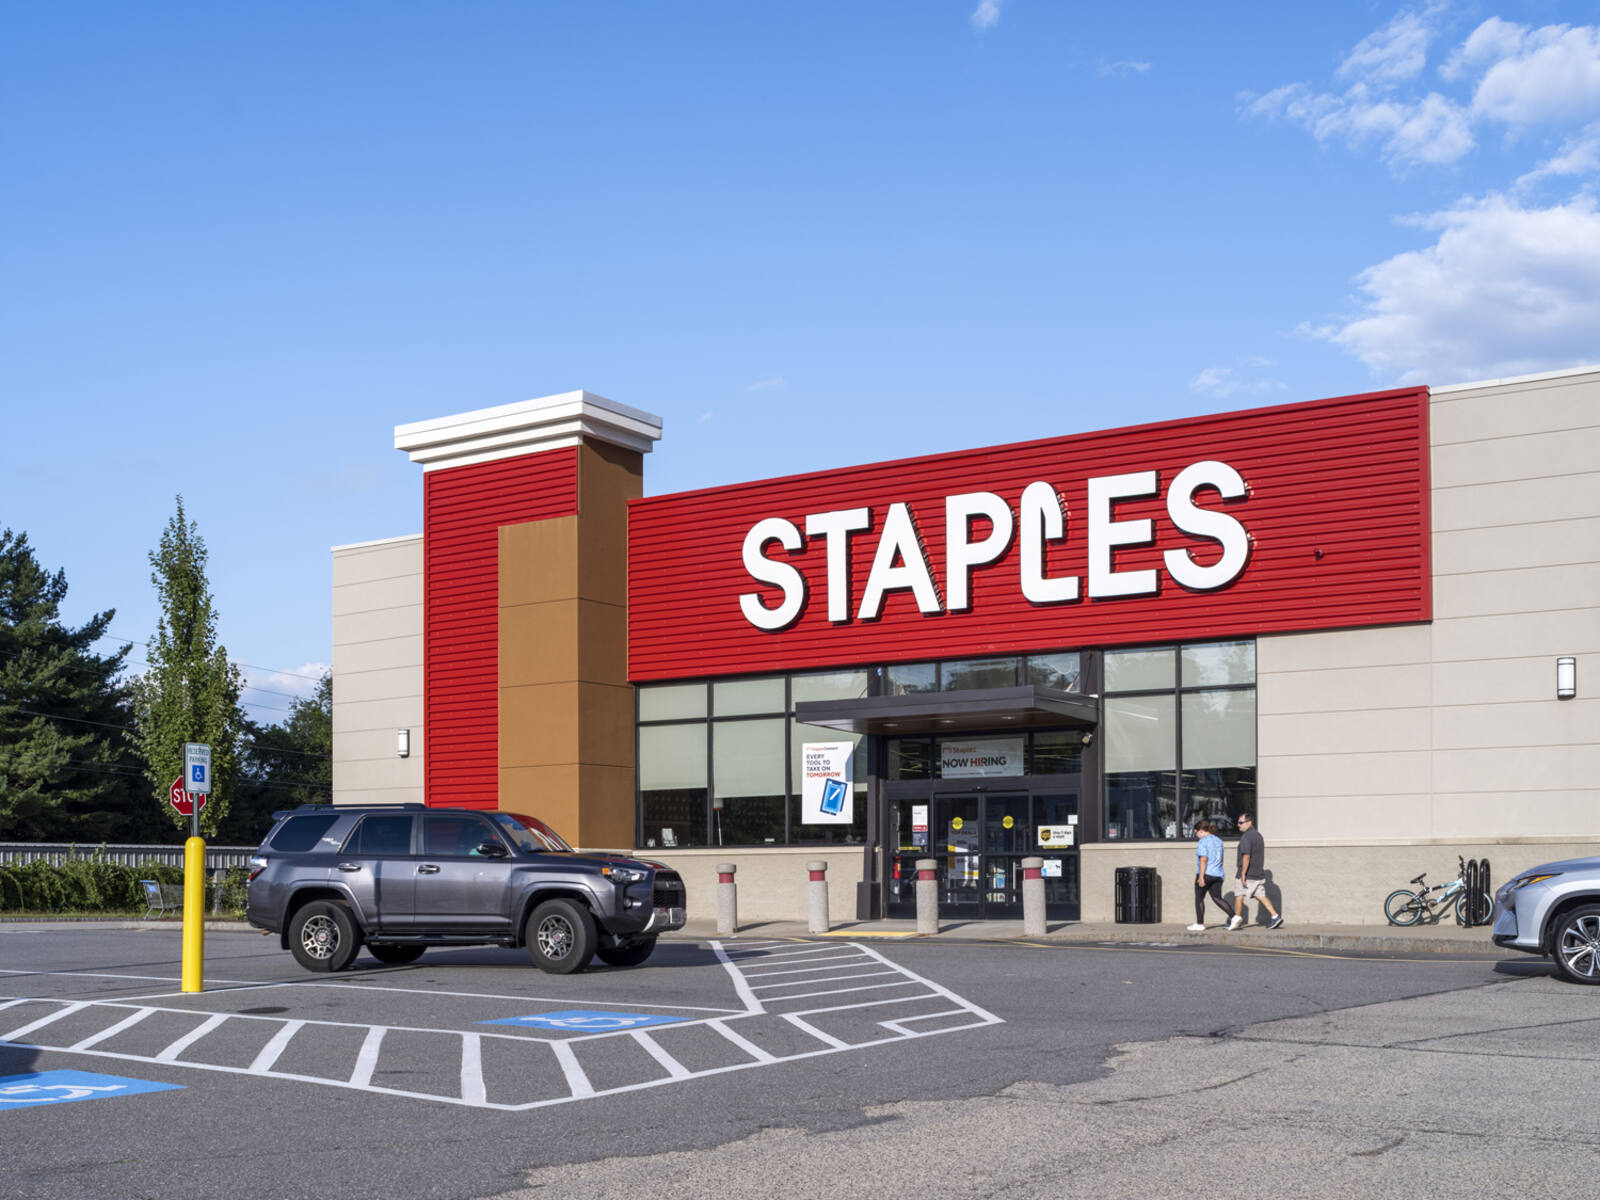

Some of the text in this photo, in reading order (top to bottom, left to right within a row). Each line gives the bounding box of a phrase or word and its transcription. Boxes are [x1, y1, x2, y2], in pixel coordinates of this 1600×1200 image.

[738, 460, 1250, 630] STAPLES
[942, 756, 1007, 769] NOW HIRING
